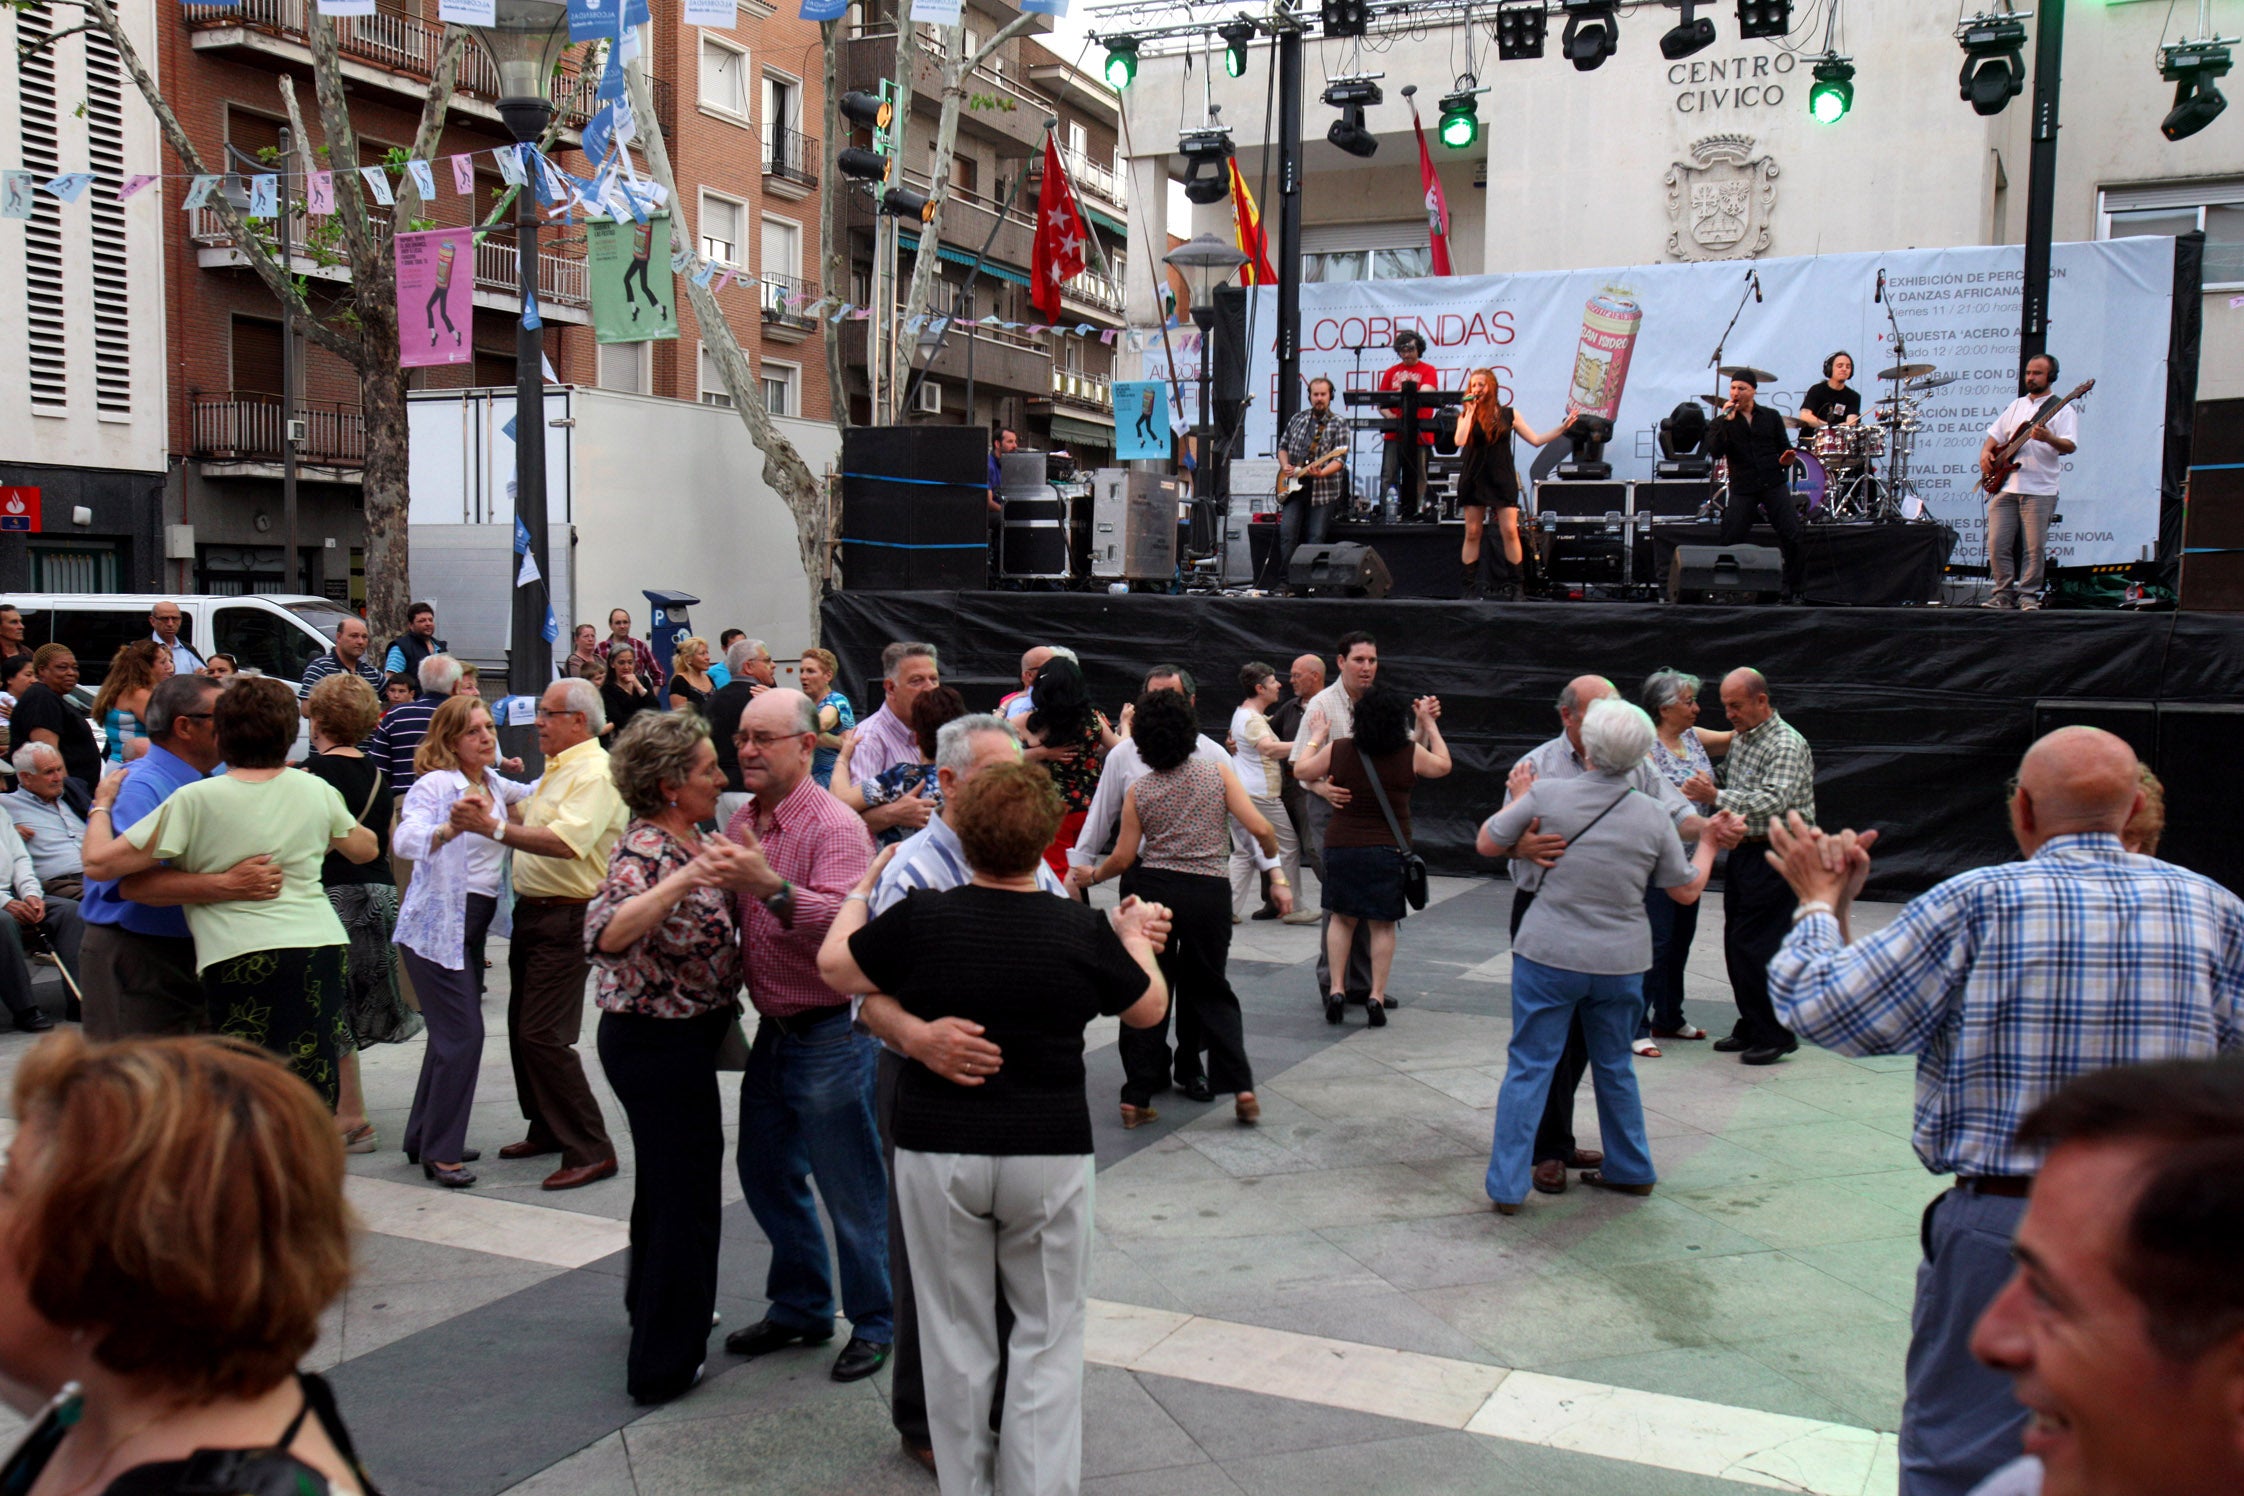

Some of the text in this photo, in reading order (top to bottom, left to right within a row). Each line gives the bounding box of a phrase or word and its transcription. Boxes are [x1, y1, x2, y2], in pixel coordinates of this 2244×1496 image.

[1667, 52, 1796, 85] CENTRO
[1676, 84, 1785, 113] CIVICO
[1889, 268, 2067, 288] EXHIBICIÓN DE PERCÓN
[1900, 289, 1951, 302] DANZAS
[1932, 306, 1945, 316] 11
[1957, 302, 1991, 315] 21:00
[1271, 310, 1515, 353] COBENDAS
[1886, 329, 1957, 343] ORQUESTA
[1599, 332, 1630, 350] ISIDRO
[1932, 345, 1946, 356] 12
[1955, 343, 1990, 356] 20:00
[1973, 369, 2003, 381] CON
[1935, 387, 1949, 397] 13
[1959, 384, 1989, 396] 19:00
[1991, 383, 2018, 395] hora
[1961, 407, 1979, 417] DE
[1982, 407, 1999, 417] LA
[1938, 422, 1955, 433] DE
[1919, 438, 1932, 449] 14
[1943, 436, 1976, 448] 20:00
[1942, 463, 1967, 474] DEL
[1965, 532, 1980, 543] EL
[2074, 531, 2115, 543] NOVIA
[655, 609, 665, 626] P
